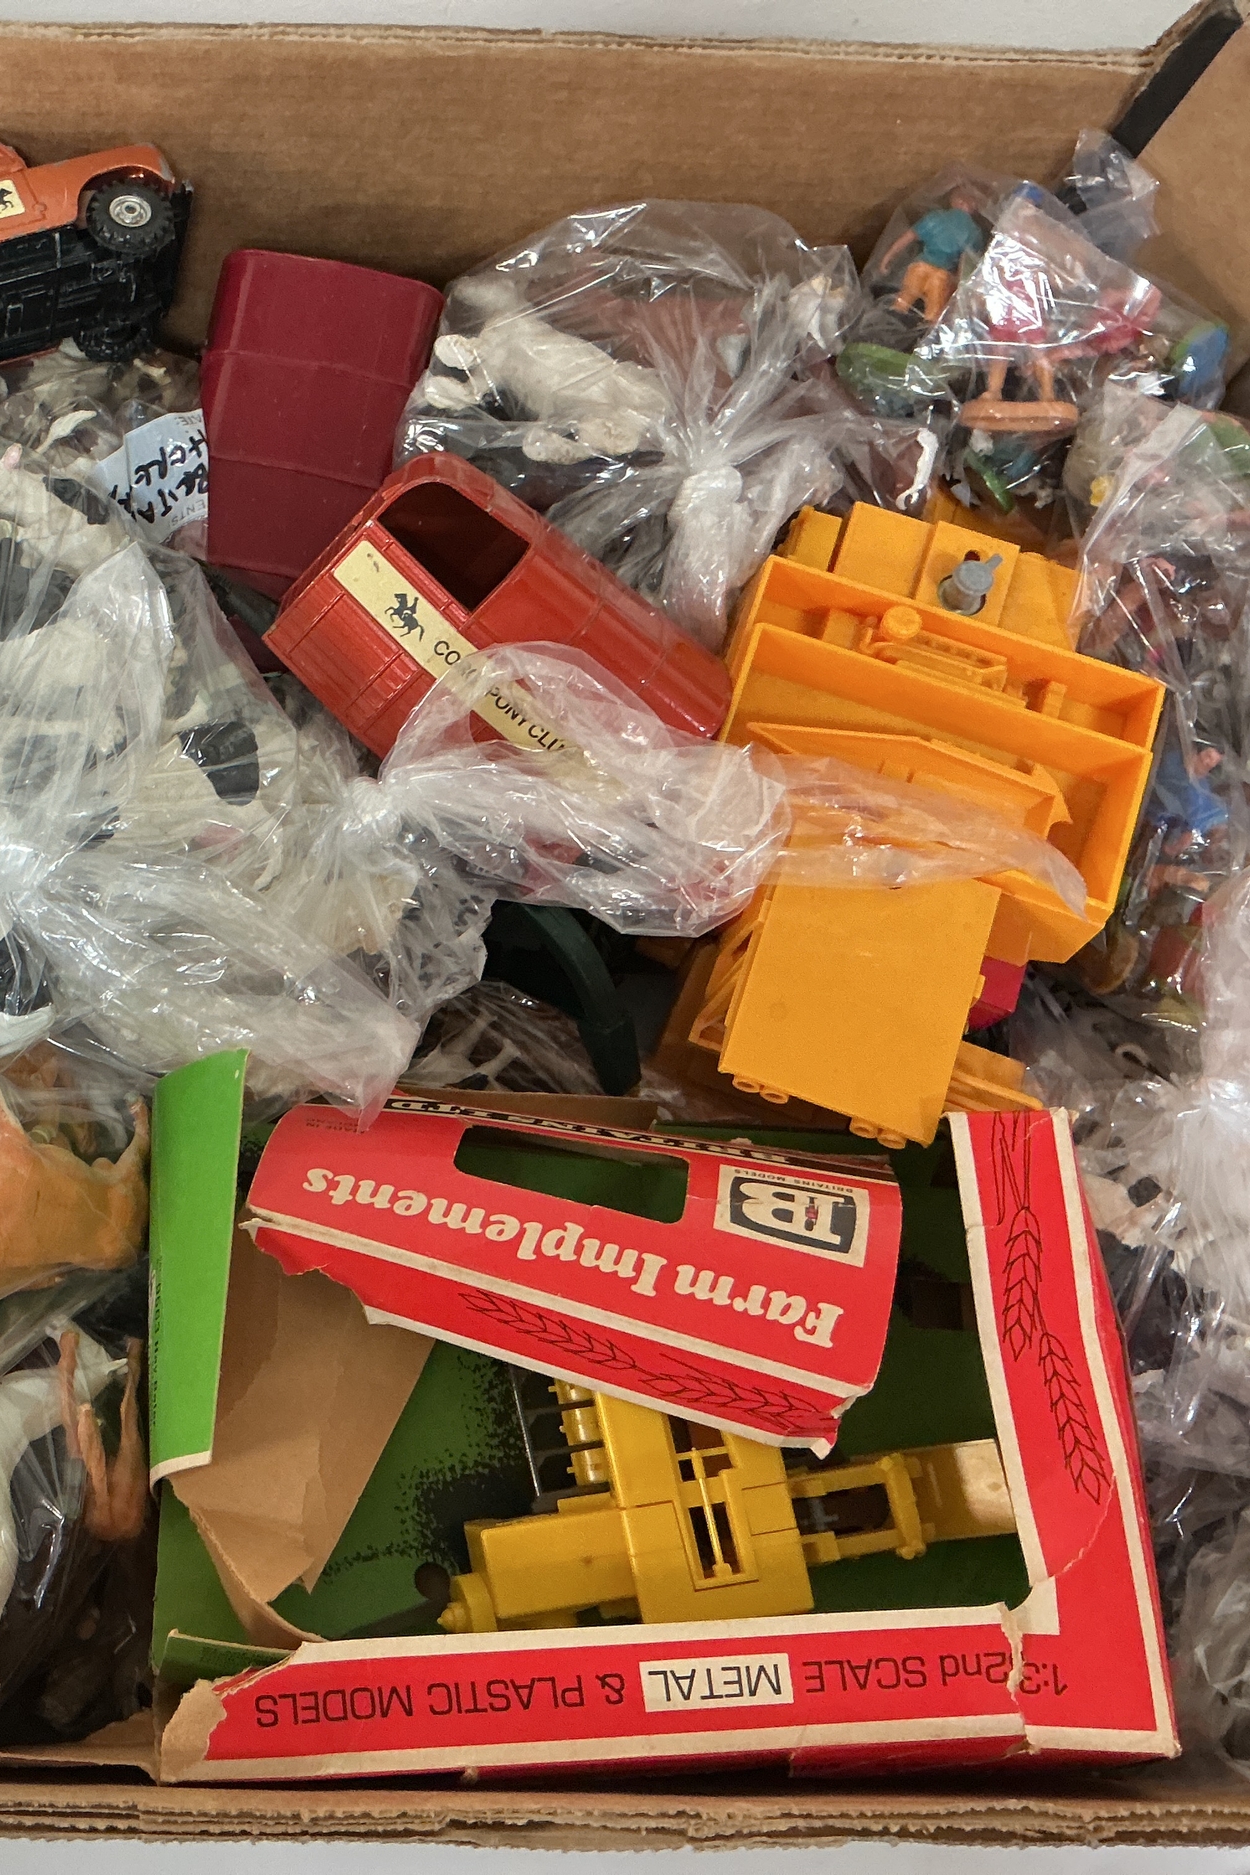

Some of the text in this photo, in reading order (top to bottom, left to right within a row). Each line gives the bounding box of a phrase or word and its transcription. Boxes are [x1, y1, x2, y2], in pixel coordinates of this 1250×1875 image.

[176, 413, 203, 427] ATE:
[527, 723, 566, 751] CLU
[733, 1168, 853, 1194] BRITAINS MODELS
[302, 1167, 845, 1348] Farm Implements
[594, 1672, 626, 1706] &
[647, 1663, 783, 1703] METAL
[801, 1656, 929, 1695] SCALE
[254, 1684, 413, 1729] MODELS
[427, 1674, 583, 1717] PLASTIC
